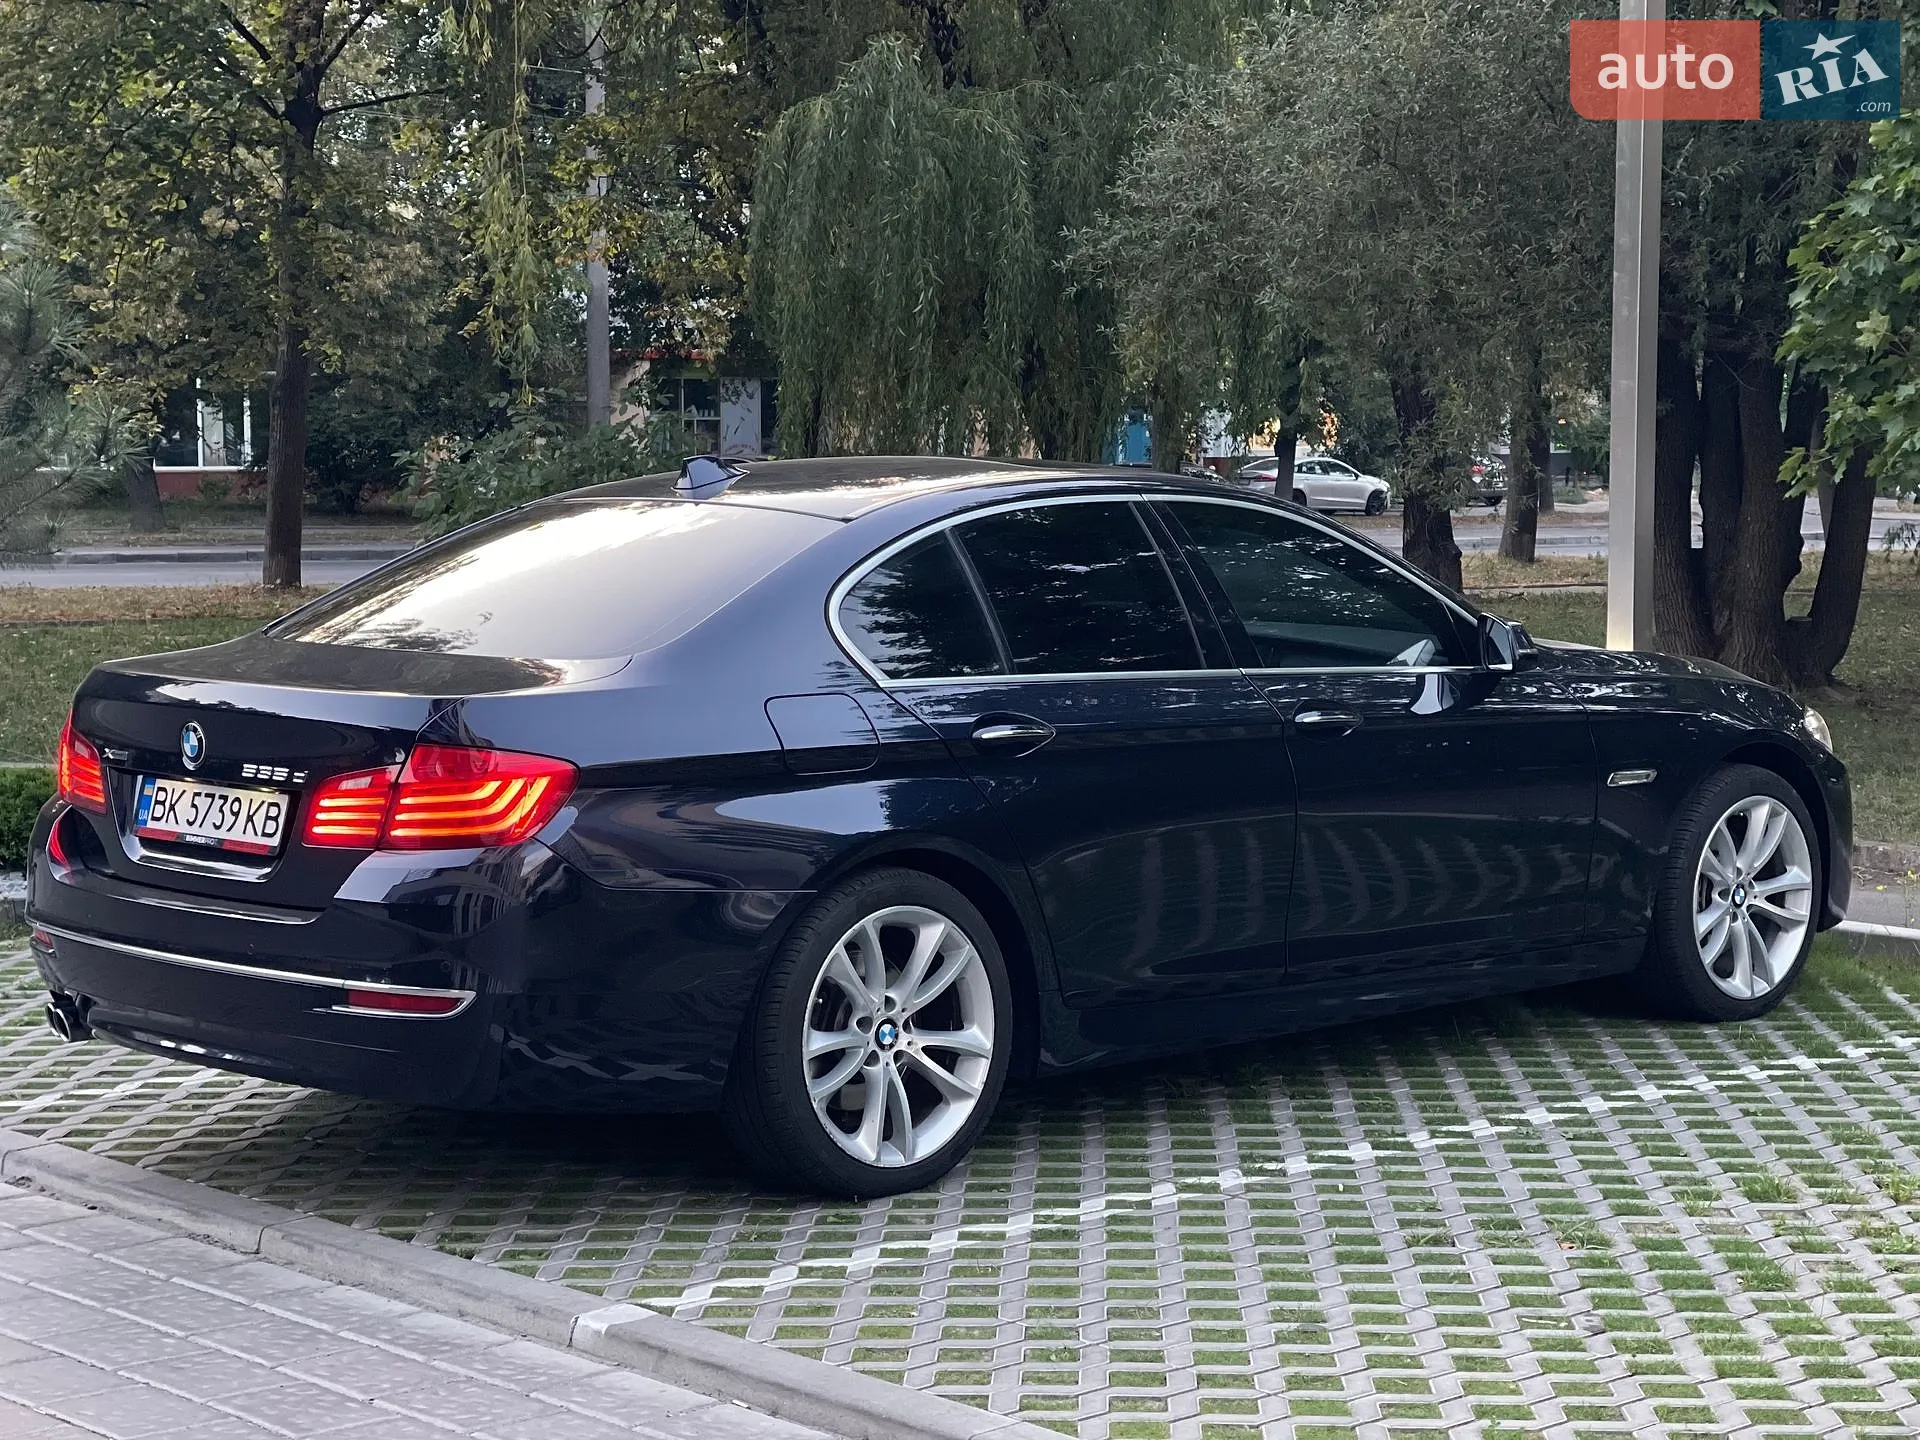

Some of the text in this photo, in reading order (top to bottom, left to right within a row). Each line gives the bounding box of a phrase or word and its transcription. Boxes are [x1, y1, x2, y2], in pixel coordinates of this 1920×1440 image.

[138, 808, 149, 821] UA
[151, 786, 282, 838] BK 5739 KB
